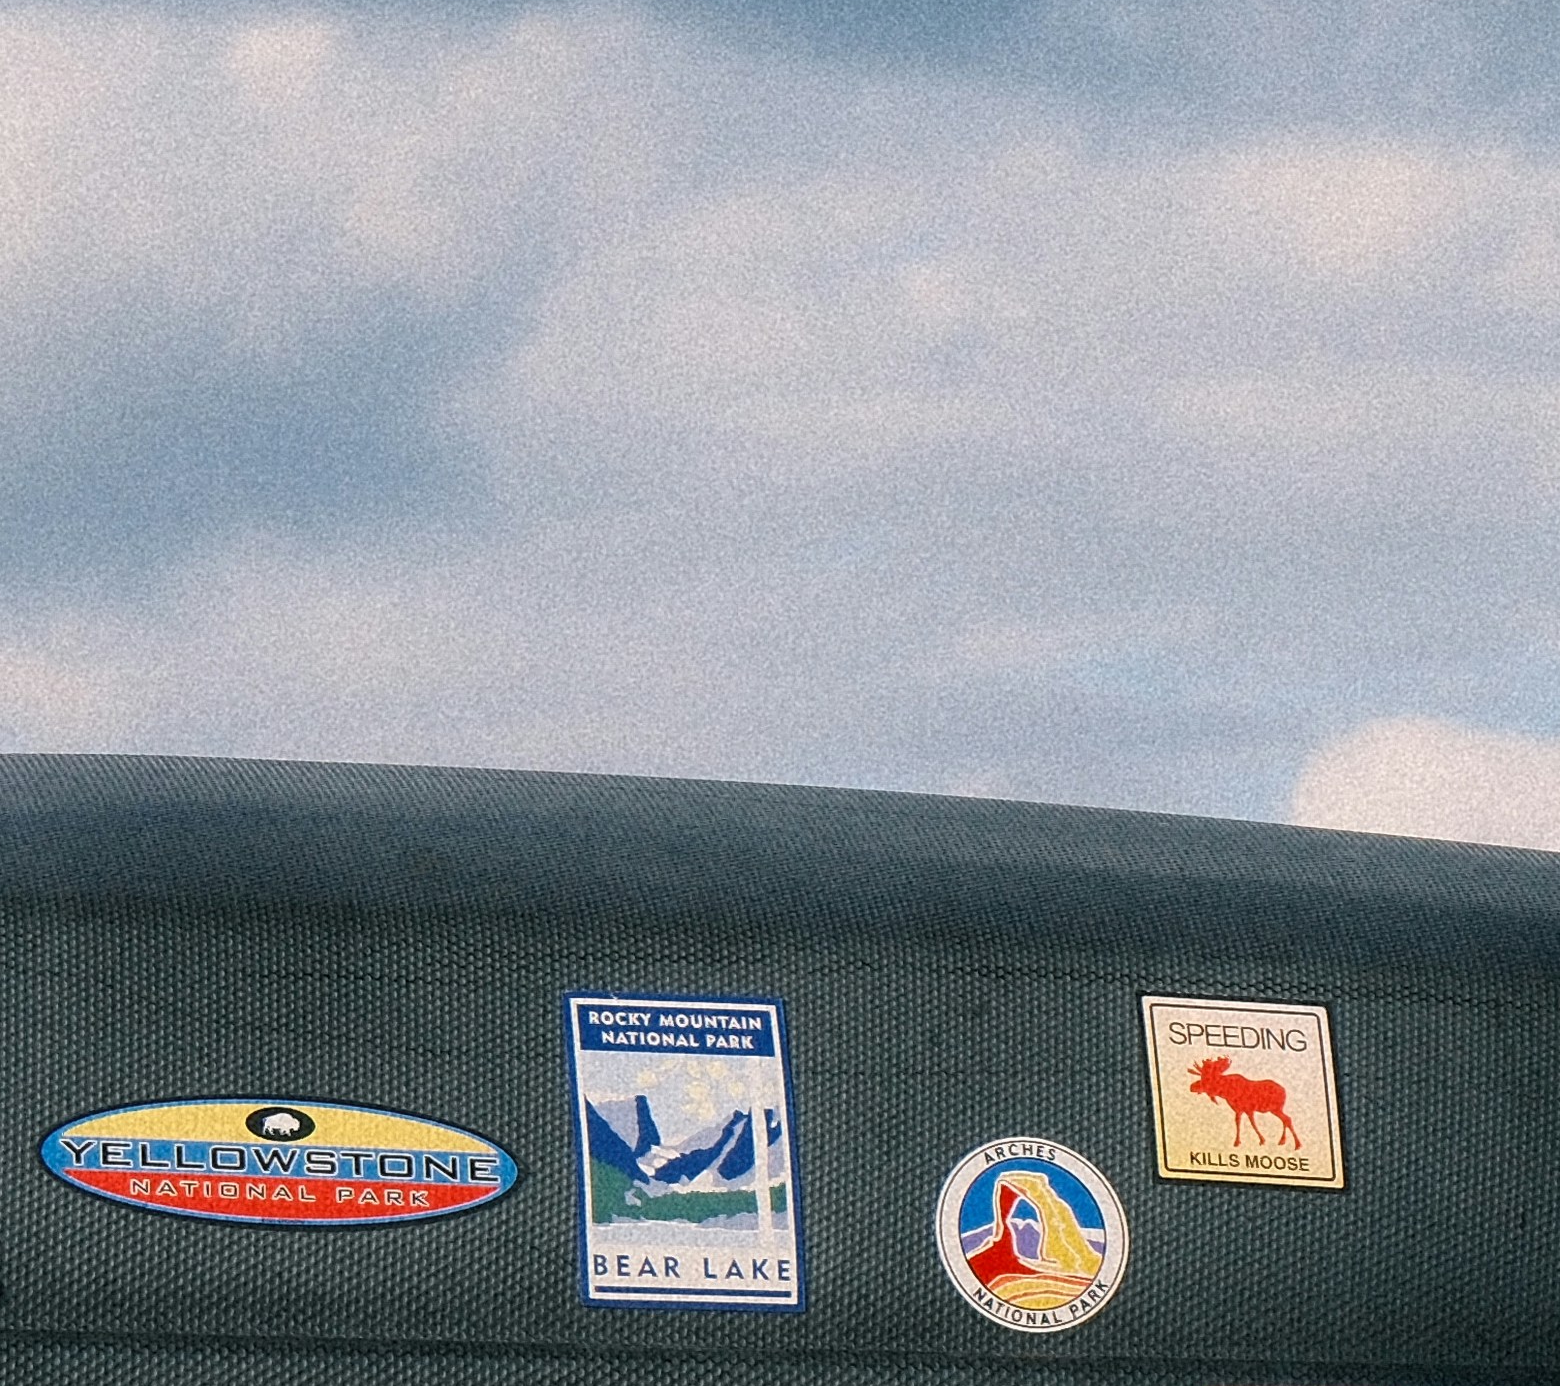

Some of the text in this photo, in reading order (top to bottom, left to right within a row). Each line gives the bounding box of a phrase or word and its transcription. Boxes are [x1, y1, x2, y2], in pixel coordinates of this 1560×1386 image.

[588, 1011, 761, 1030] ROCKY MOUNTAIN
[602, 1032, 754, 1050] NATIONAL PARK
[1169, 1021, 1307, 1052] SPEEDING
[59, 1138, 501, 1184] YELLOWSTONE
[984, 1143, 1057, 1165] ARCHES
[1190, 1151, 1310, 1171] KILLS MOOSE
[130, 1178, 429, 1207] NATIONAL PARK
[593, 1254, 791, 1281] BEAR LAKE
[972, 1280, 1109, 1325] NATIONAL PARK
